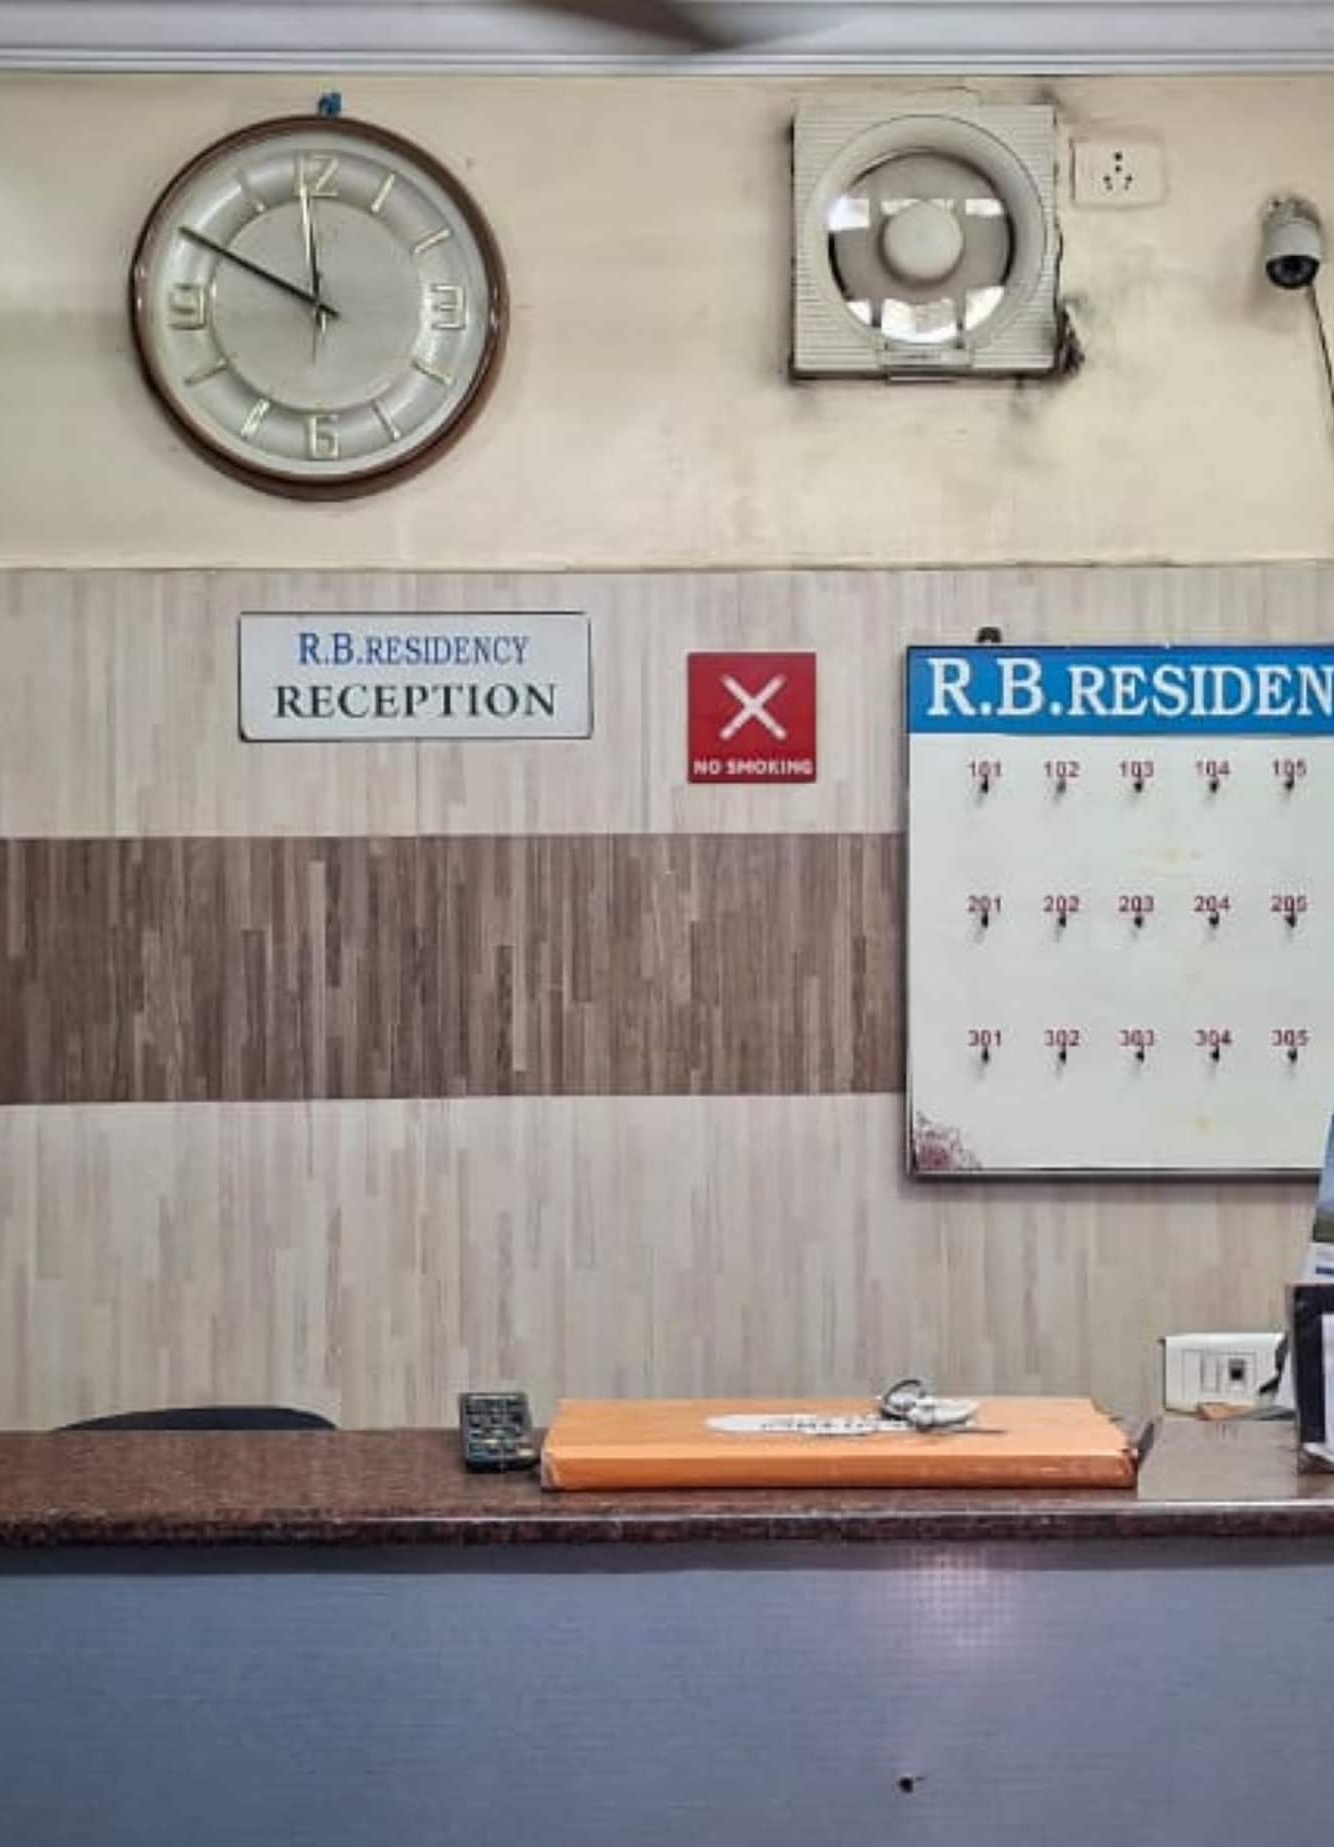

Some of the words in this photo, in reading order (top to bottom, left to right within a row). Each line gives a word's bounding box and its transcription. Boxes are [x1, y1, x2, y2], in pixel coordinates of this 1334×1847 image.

[274, 682, 557, 719] RECEPTION
[693, 759, 722, 776] NO
[727, 759, 814, 776] SMOKING
[968, 760, 1002, 777] 101
[1044, 760, 1082, 777] 102
[1120, 760, 1155, 777] 103
[1195, 759, 1231, 777] 104
[1273, 759, 1308, 777] 105
[968, 895, 1001, 912] 201
[1044, 895, 1080, 912] 202
[1119, 895, 1155, 912] 203
[1194, 895, 1231, 912] 204
[968, 1030, 1002, 1046] 301
[1044, 1030, 1081, 1046] 302
[1119, 1030, 1155, 1046] 303
[1195, 1030, 1232, 1046] 304
[1272, 1030, 1309, 1046] 305
